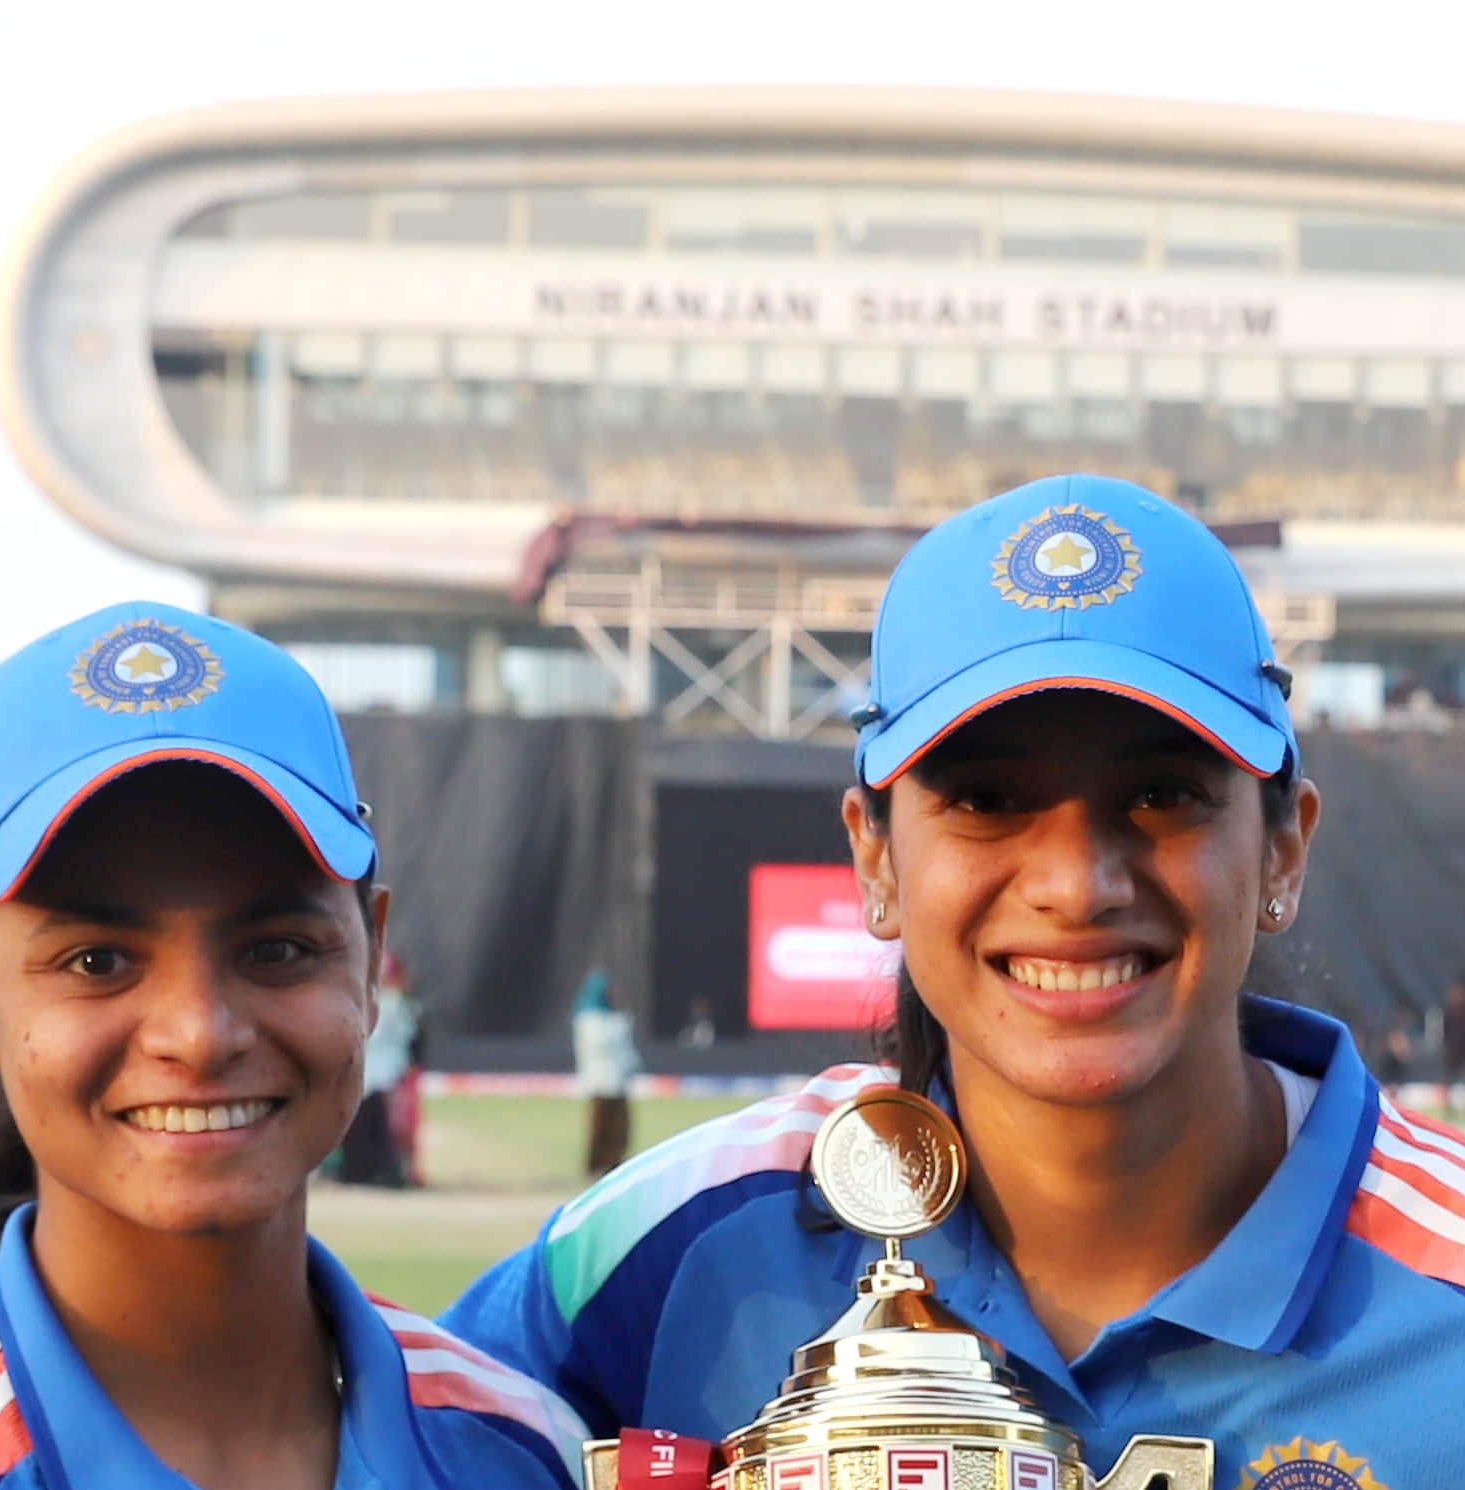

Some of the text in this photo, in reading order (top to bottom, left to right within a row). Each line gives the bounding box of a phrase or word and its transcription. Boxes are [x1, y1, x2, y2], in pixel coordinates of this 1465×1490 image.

[537, 286, 1279, 338] NIRANJAN SHAH STADIUM
[1310, 1473, 1333, 1486] FOR
